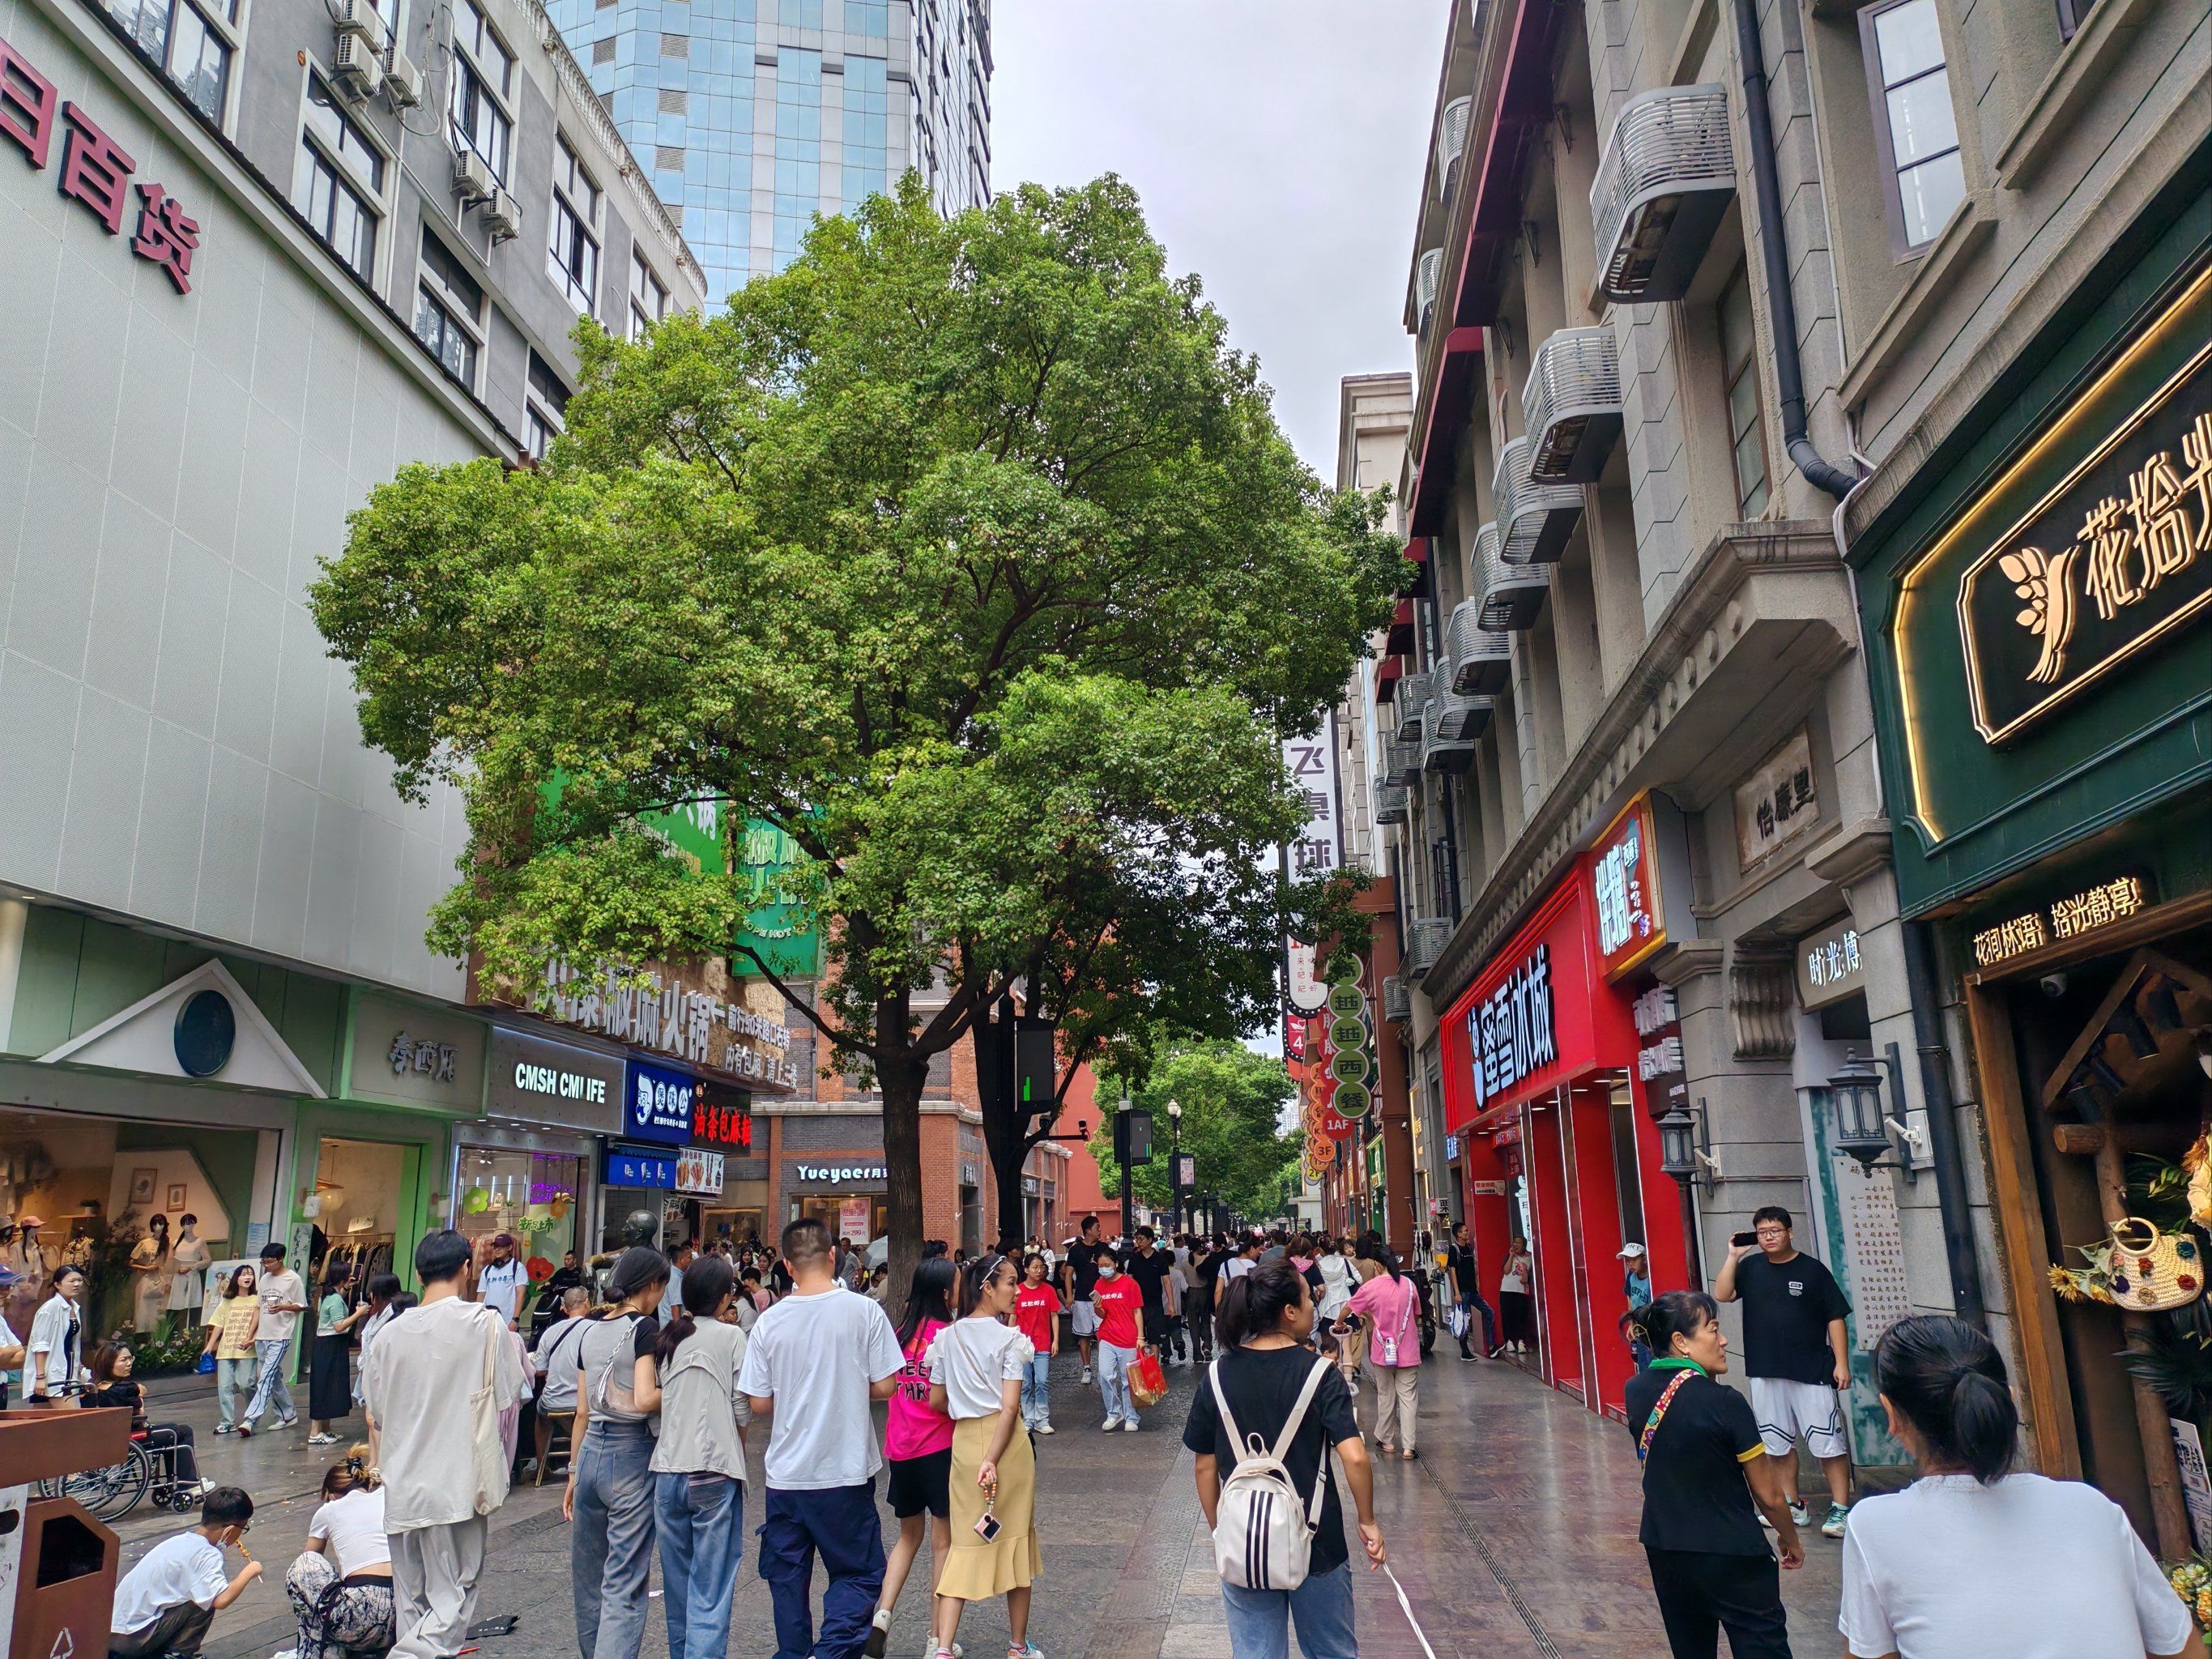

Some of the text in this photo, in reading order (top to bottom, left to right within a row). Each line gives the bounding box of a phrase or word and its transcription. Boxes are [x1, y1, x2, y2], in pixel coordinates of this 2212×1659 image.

[769, 928, 792, 938] HOT
[1480, 943, 1554, 1098] 蜜雪冰城
[515, 1063, 556, 1094] CMSH
[1328, 1120, 1349, 1130] 1AF
[1318, 1146, 1332, 1156] 3F
[797, 1166, 870, 1183] Yueyaer
